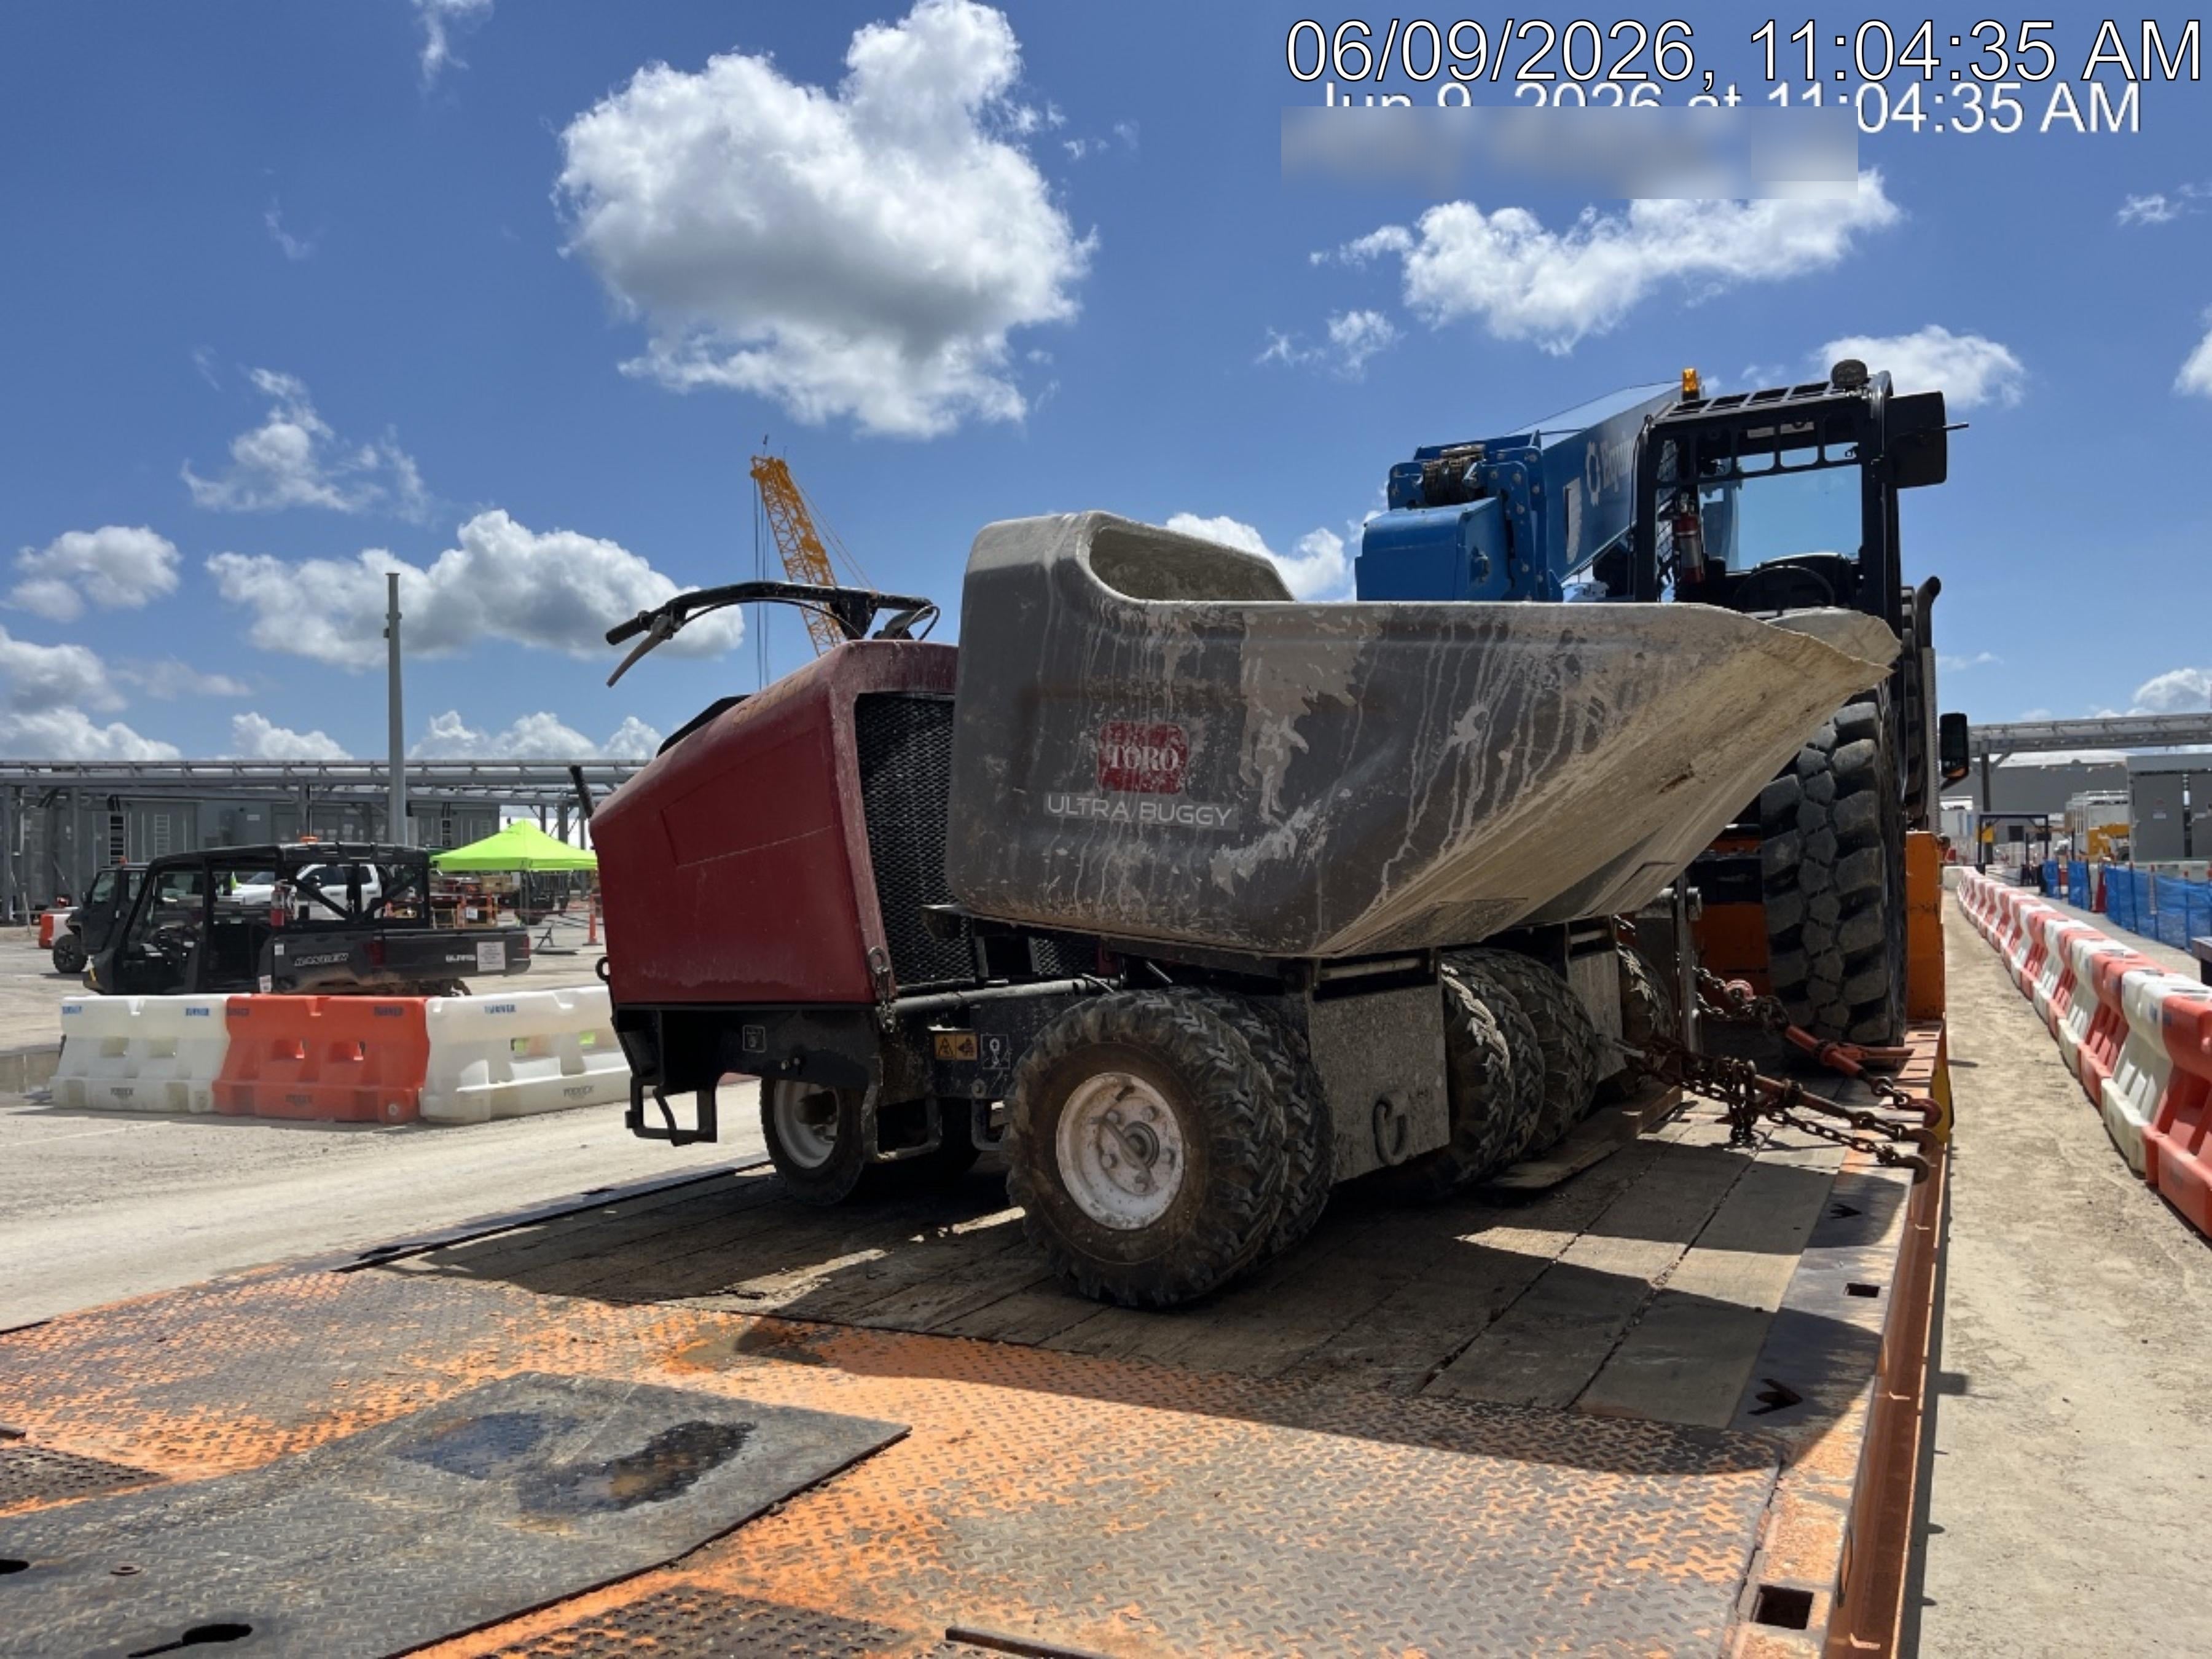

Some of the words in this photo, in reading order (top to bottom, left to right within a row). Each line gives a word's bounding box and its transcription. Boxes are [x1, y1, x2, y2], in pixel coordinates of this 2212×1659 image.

[1108, 745, 1180, 772] TORO
[1047, 794, 1128, 820] ULTRA
[1139, 803, 1233, 827] BUGGY
